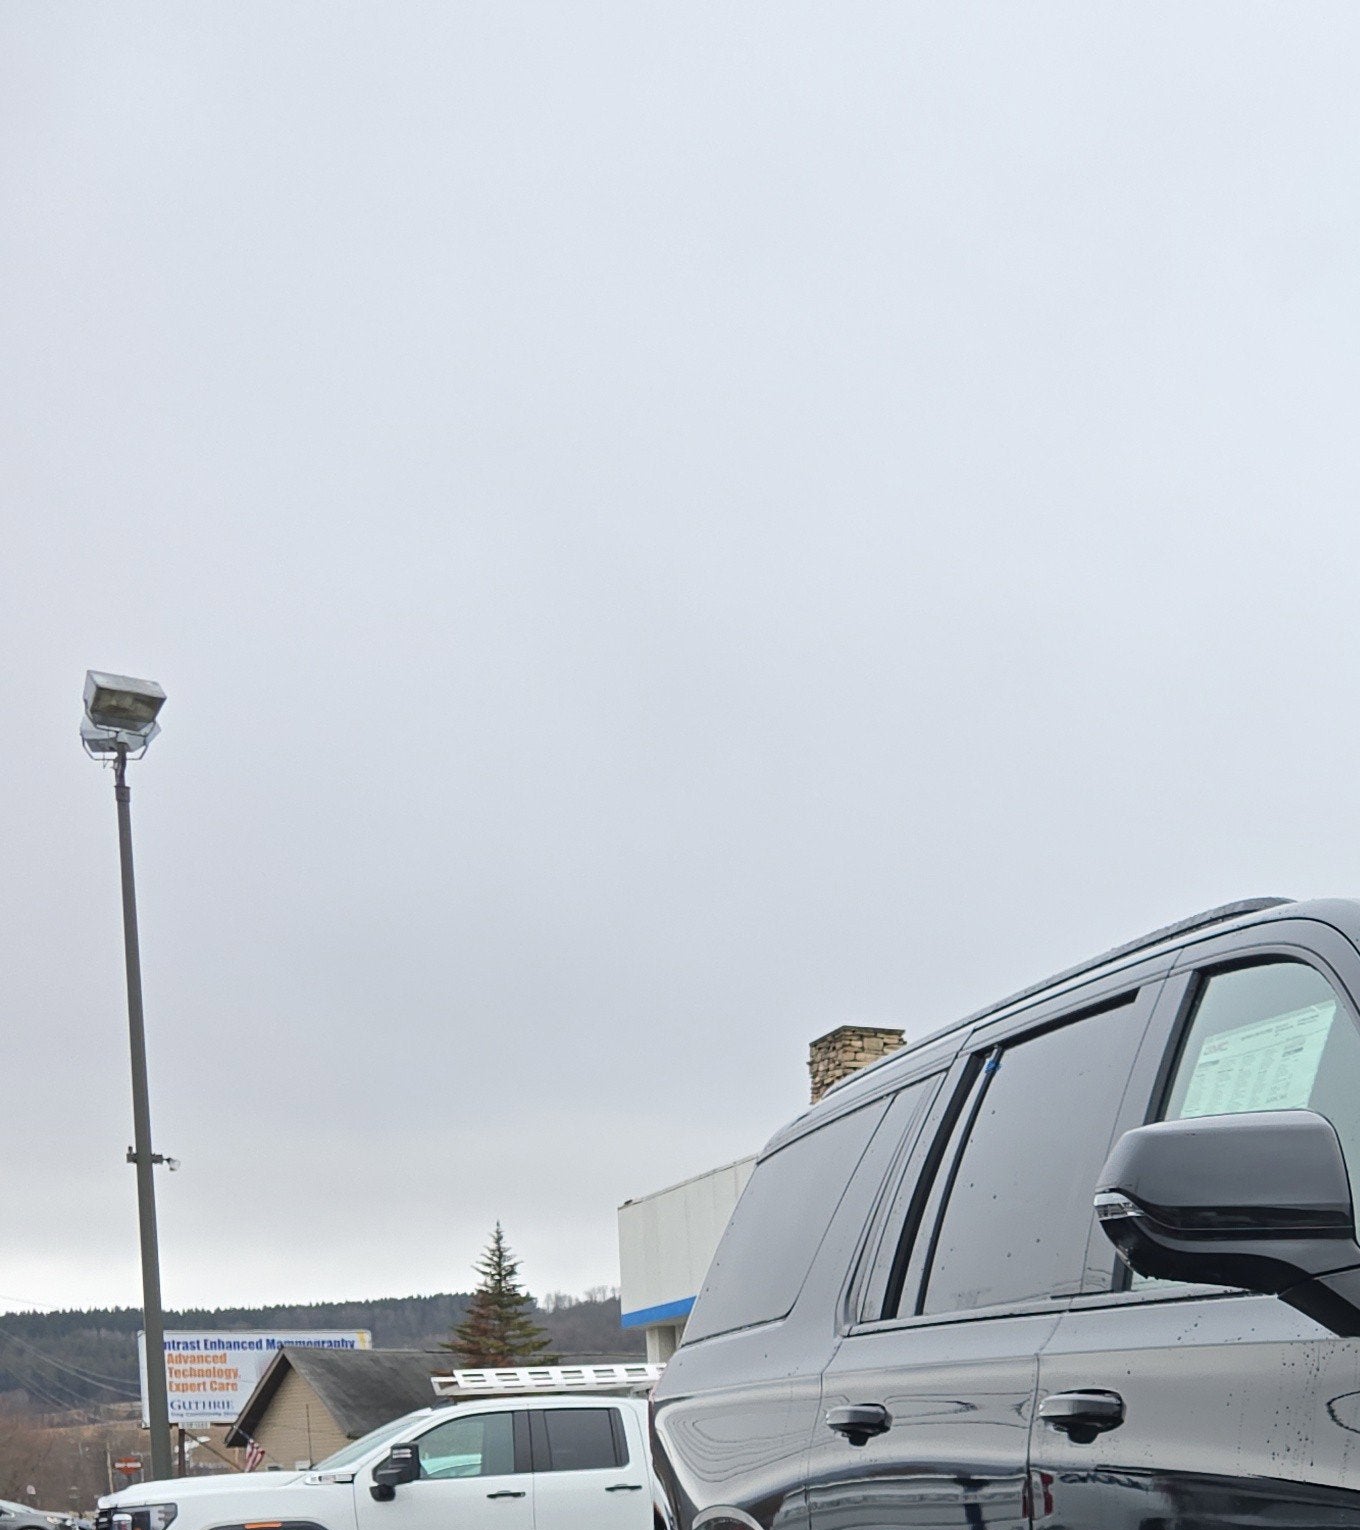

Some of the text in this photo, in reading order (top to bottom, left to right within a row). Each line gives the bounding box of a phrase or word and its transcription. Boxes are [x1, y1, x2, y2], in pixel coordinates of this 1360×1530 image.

[163, 1338, 201, 1351] ntrast
[203, 1338, 263, 1351] Enhanced
[167, 1353, 227, 1365] Advanced
[169, 1380, 238, 1393] Expert Care
[170, 1400, 234, 1411] GUTHRIE
